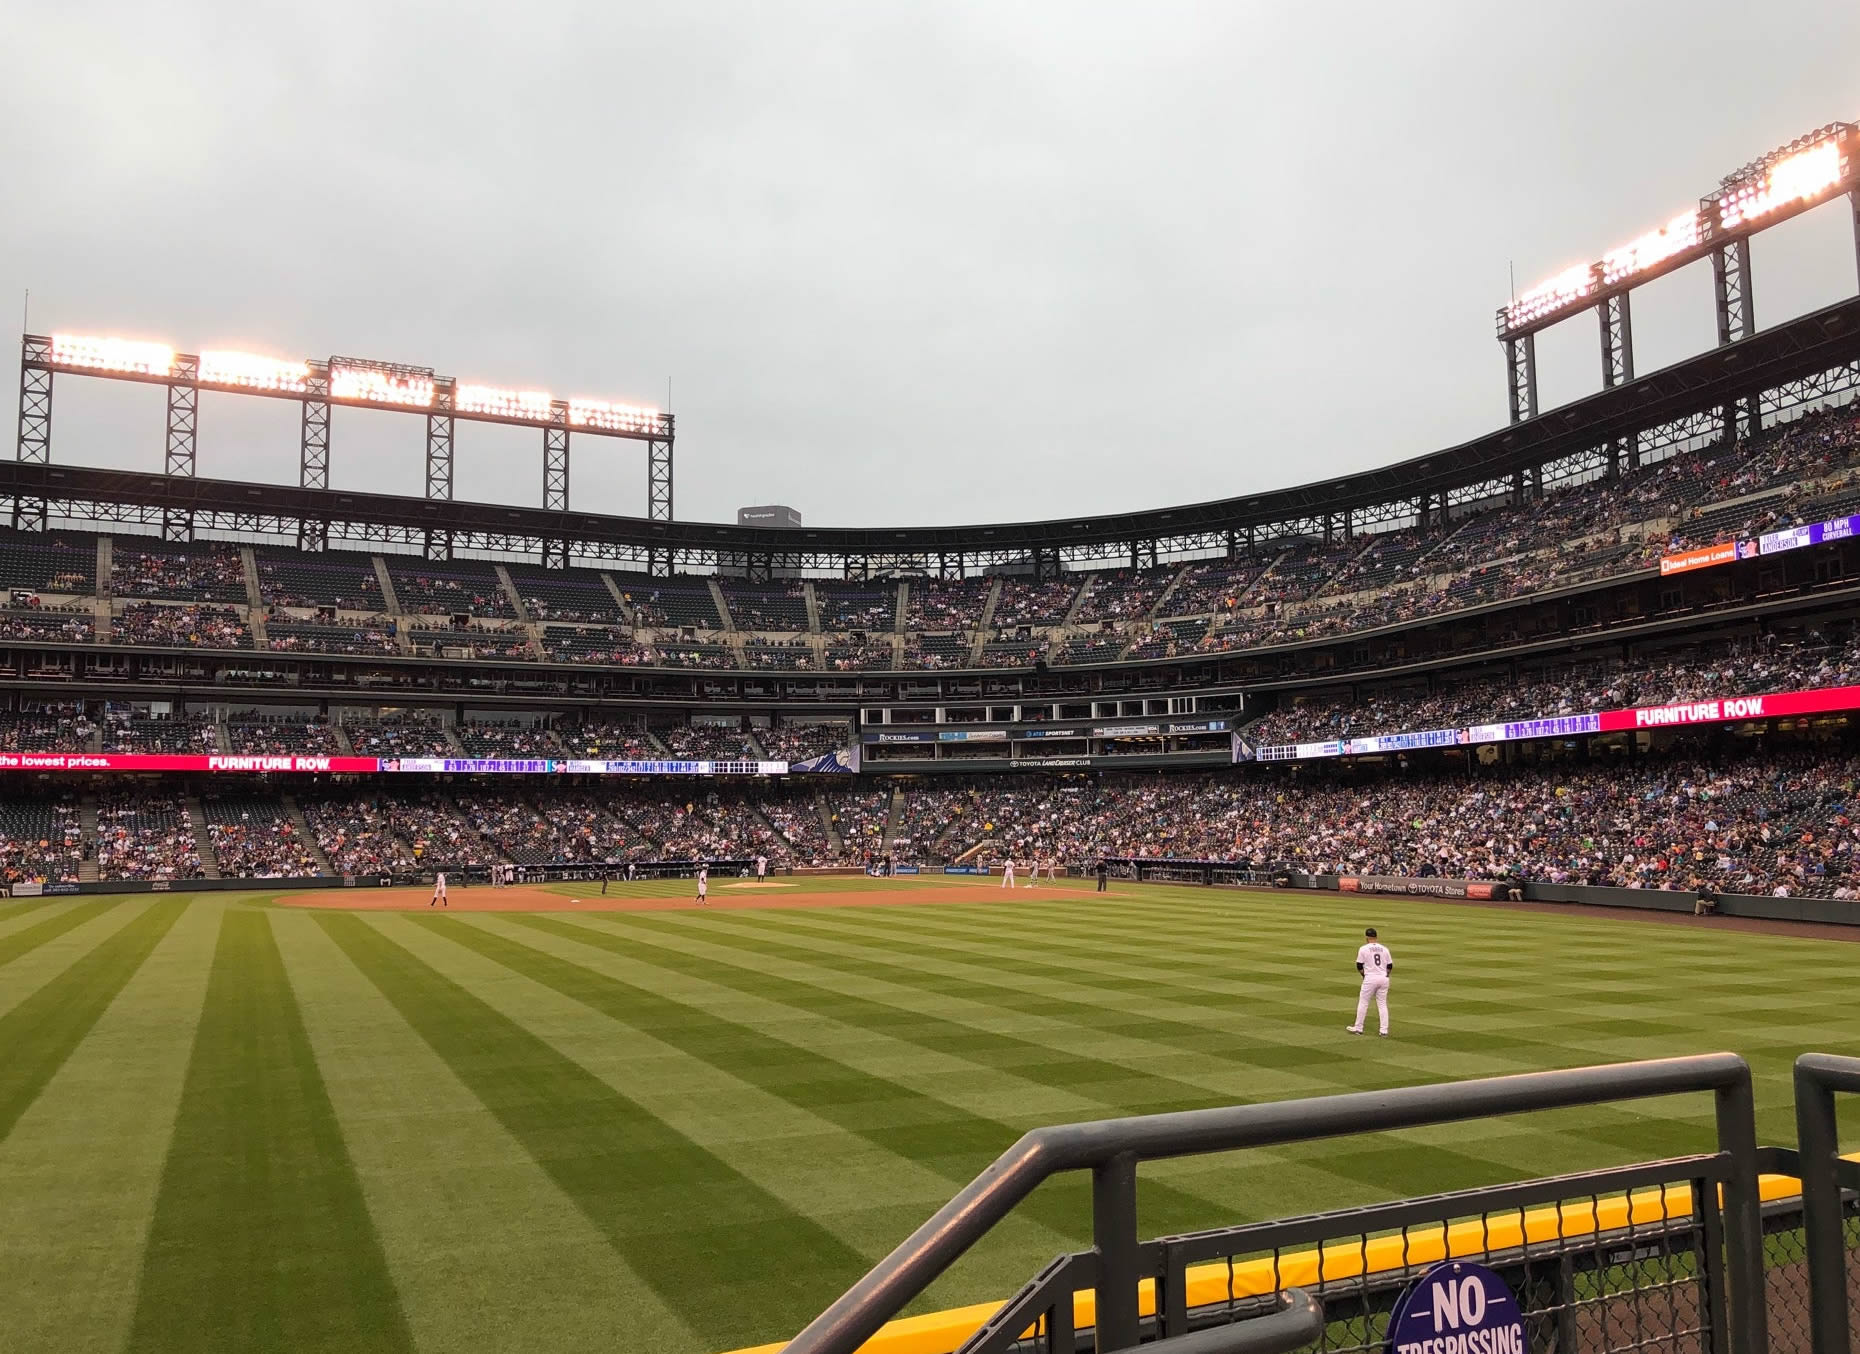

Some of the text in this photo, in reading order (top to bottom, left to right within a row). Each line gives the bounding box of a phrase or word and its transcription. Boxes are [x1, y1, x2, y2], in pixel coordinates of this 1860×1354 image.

[1823, 518, 1849, 532] 80 MPH
[1822, 528, 1853, 541] CURVEBALL
[1765, 537, 1797, 553] ANDERSON
[1669, 550, 1734, 569] Ideal Home Loans
[1636, 702, 1719, 726] FURNITURE
[21, 756, 65, 767] lowest
[67, 756, 111, 768] prices.
[208, 757, 292, 770] FURNITURE
[1360, 881, 1374, 891] Your
[1374, 881, 1407, 893] Hometown
[1418, 884, 1443, 894] TOYOTA
[1445, 885, 1465, 896] Stores
[1374, 953, 1382, 966] 8
[1432, 1275, 1486, 1333] NO
